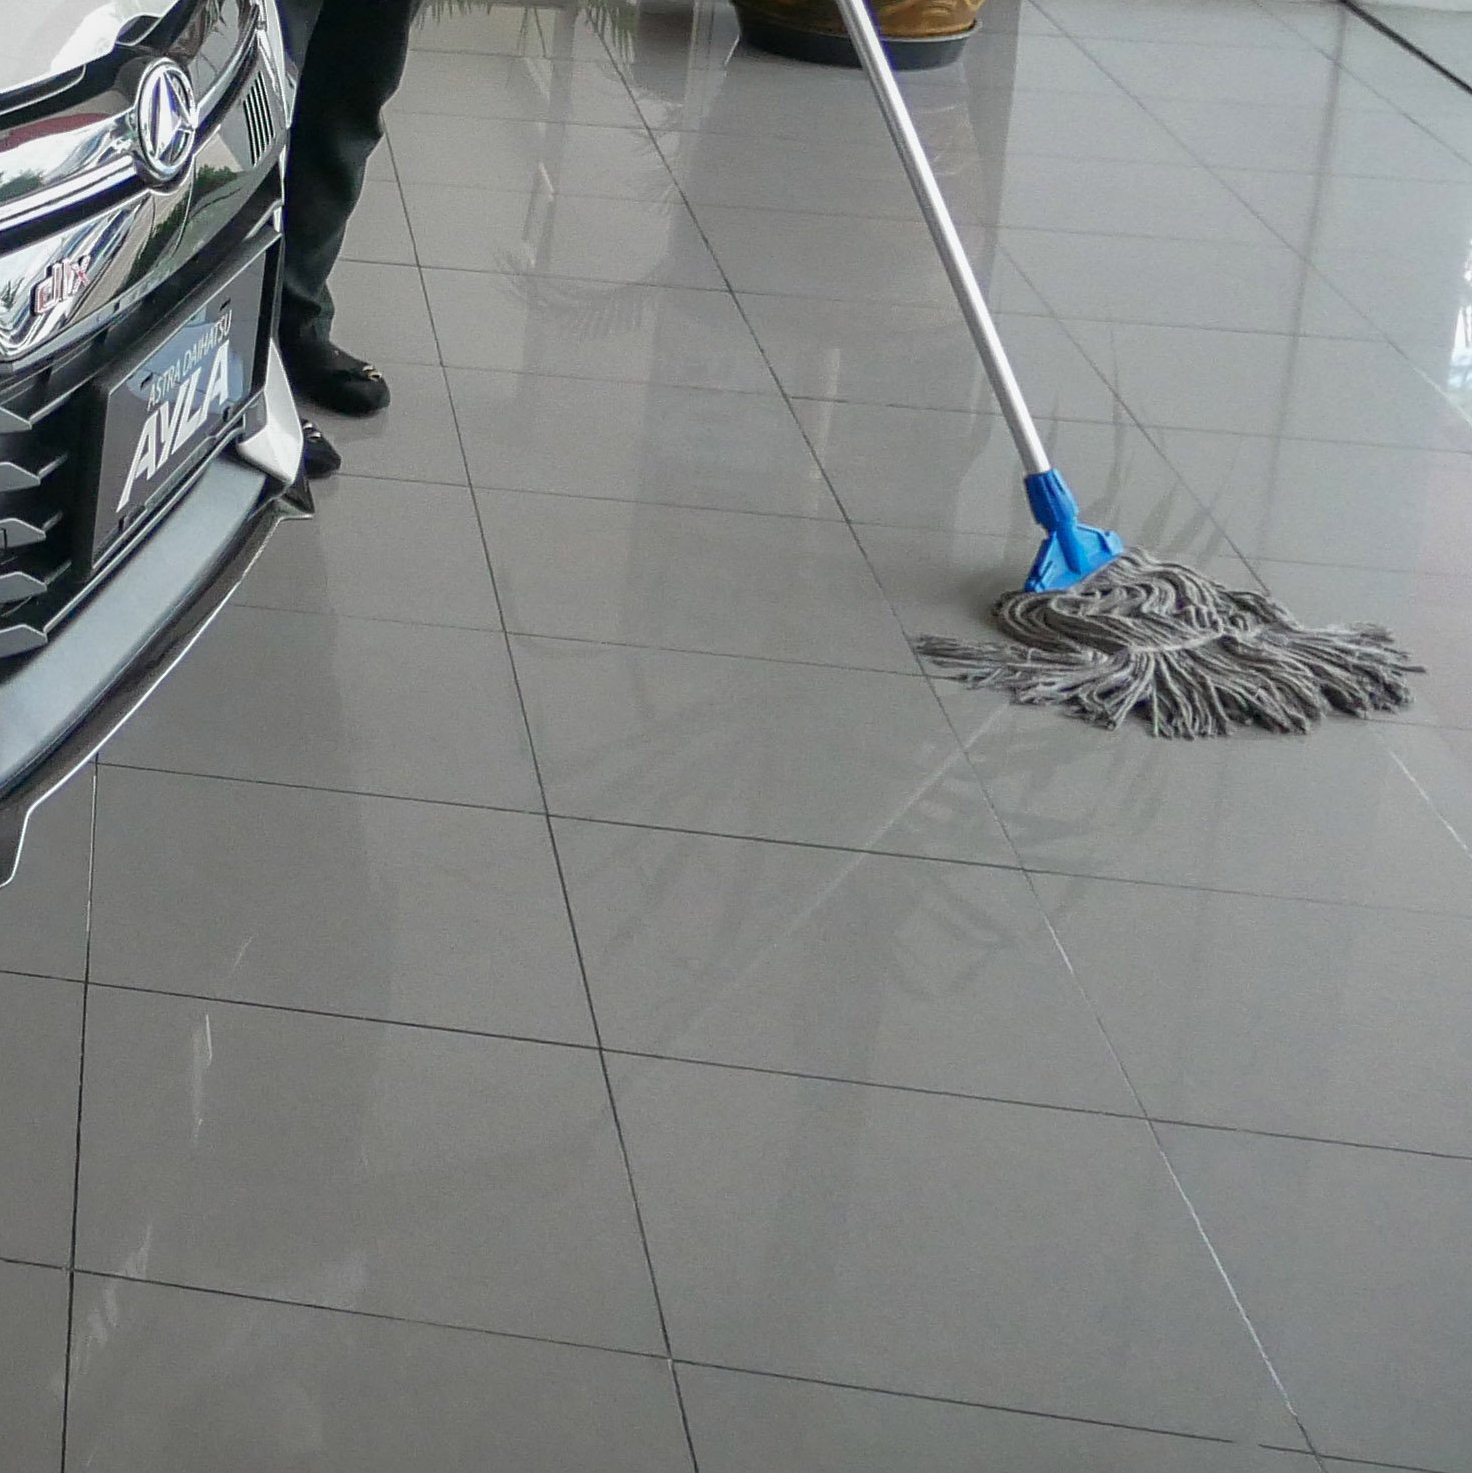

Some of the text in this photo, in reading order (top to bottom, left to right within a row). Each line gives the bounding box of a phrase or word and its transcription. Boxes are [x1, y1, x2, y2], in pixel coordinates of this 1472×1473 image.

[116, 339, 230, 513] AYLA
[147, 309, 232, 412] ASTRA DAIHATSU
